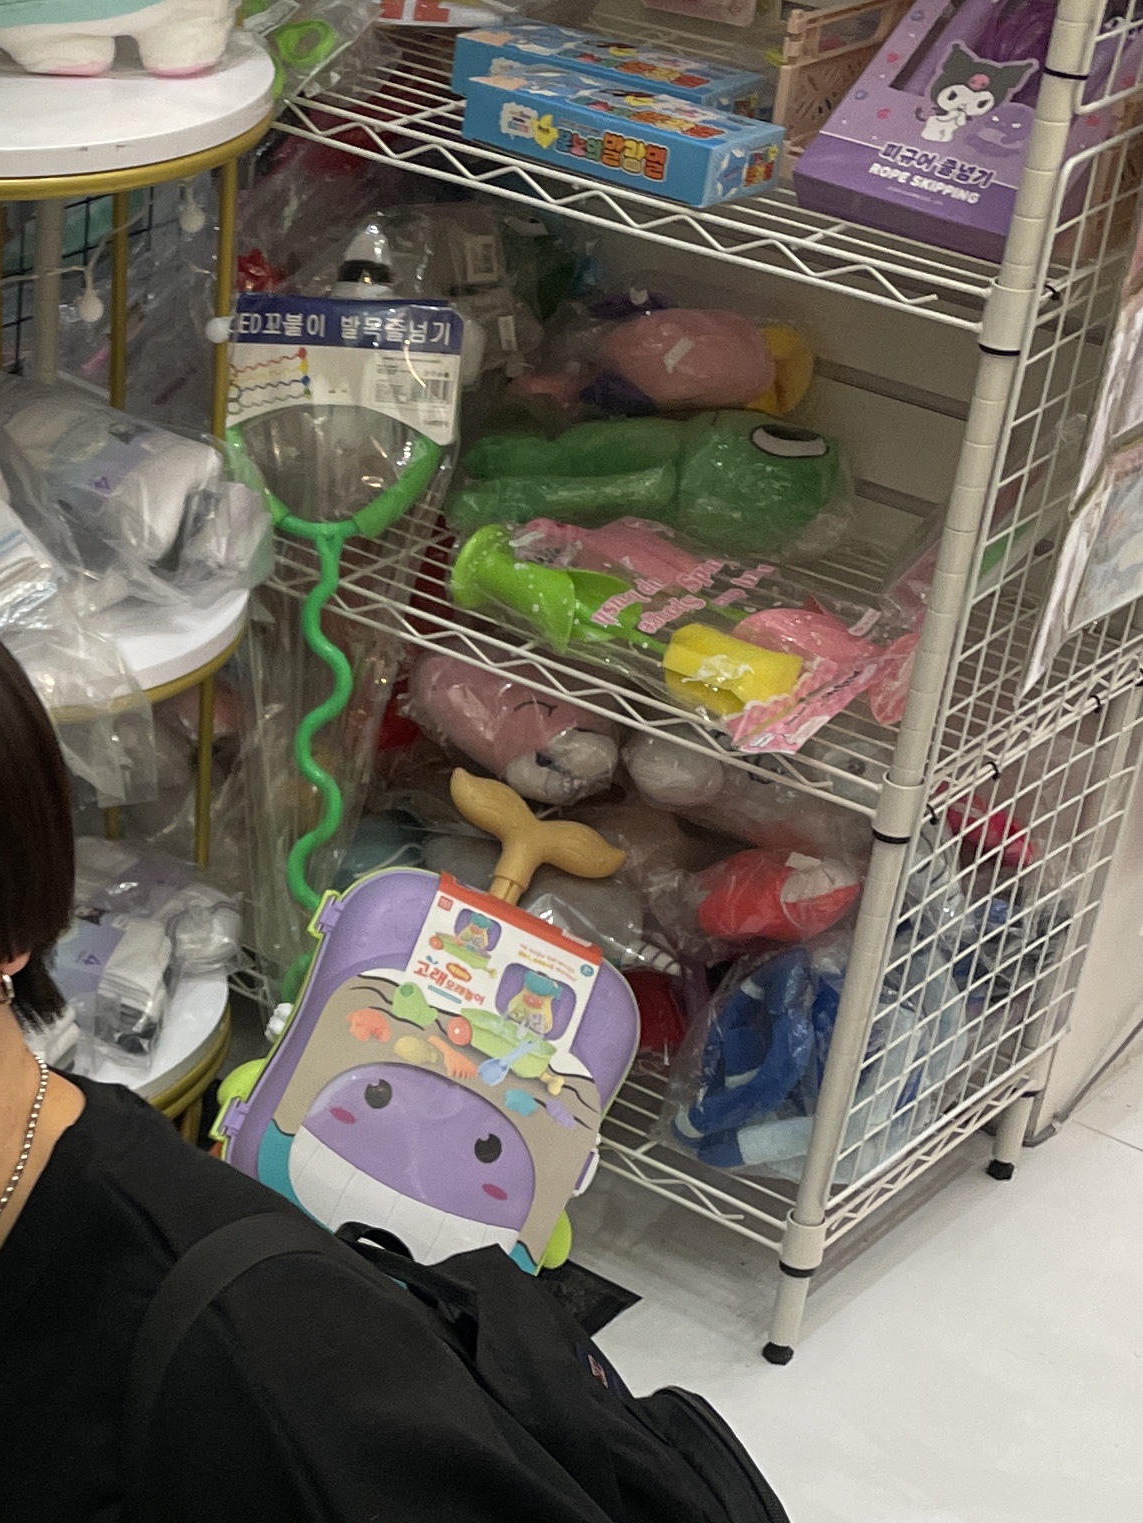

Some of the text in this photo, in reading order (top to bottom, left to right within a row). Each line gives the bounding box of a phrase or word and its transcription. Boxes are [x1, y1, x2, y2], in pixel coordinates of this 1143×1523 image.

[868, 162, 911, 183] ROPE
[909, 175, 981, 204] SKIPPING
[880, 142, 996, 188] 피규어 줄넘기
[340, 315, 452, 346] 발목줄넘기
